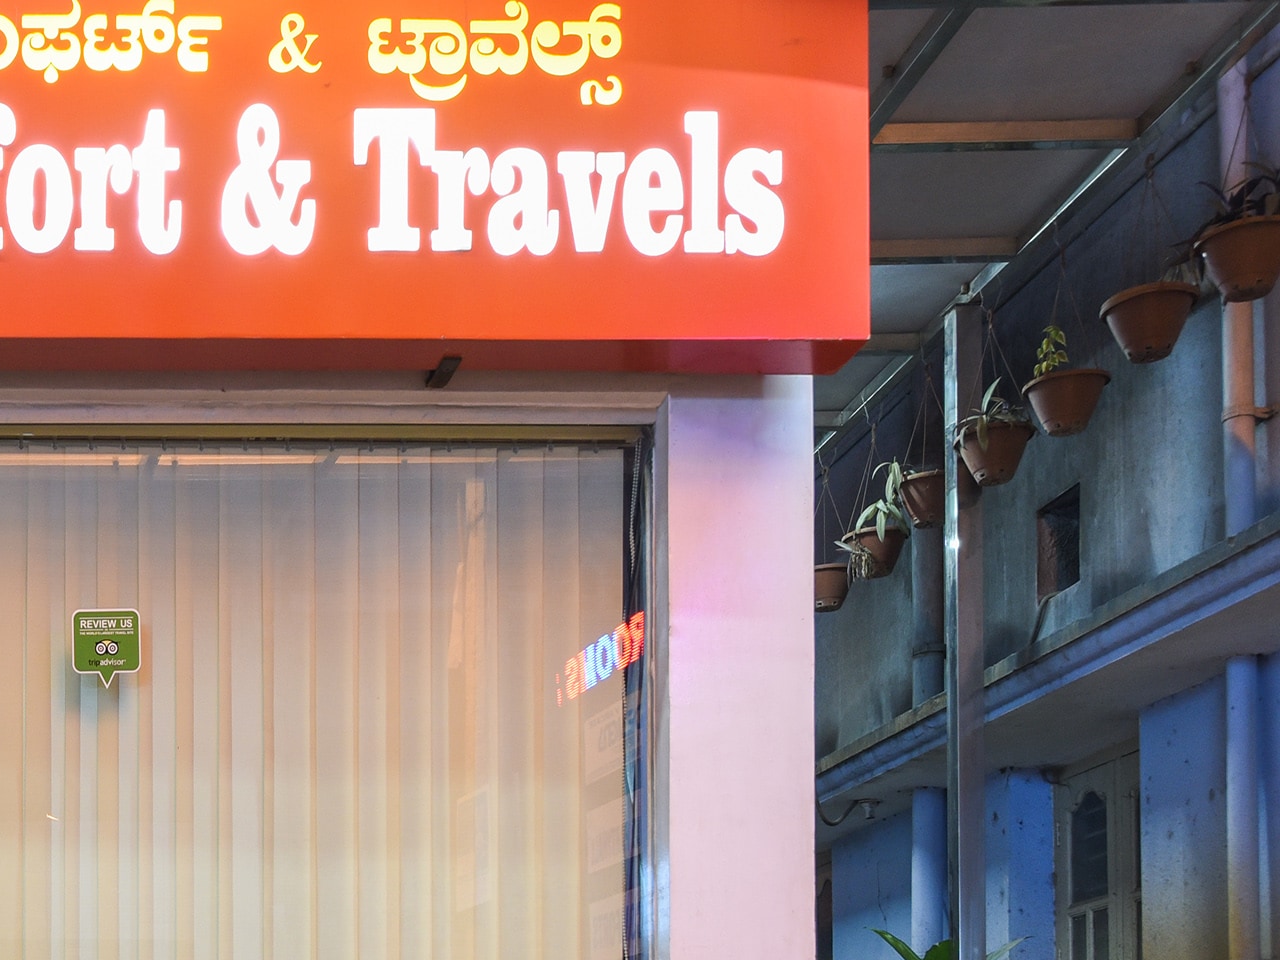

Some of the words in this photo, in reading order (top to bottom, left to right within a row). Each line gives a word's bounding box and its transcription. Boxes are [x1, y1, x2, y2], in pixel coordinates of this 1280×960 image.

[268, 13, 322, 73] &
[367, 0, 623, 105] ಟ್ರಾವೆಲ್ಸ್
[220, 102, 317, 256] &
[353, 107, 786, 256] Travels
[80, 619, 117, 629] REVIEW
[120, 619, 133, 628] US
[88, 658, 125, 667] tripadvisor
